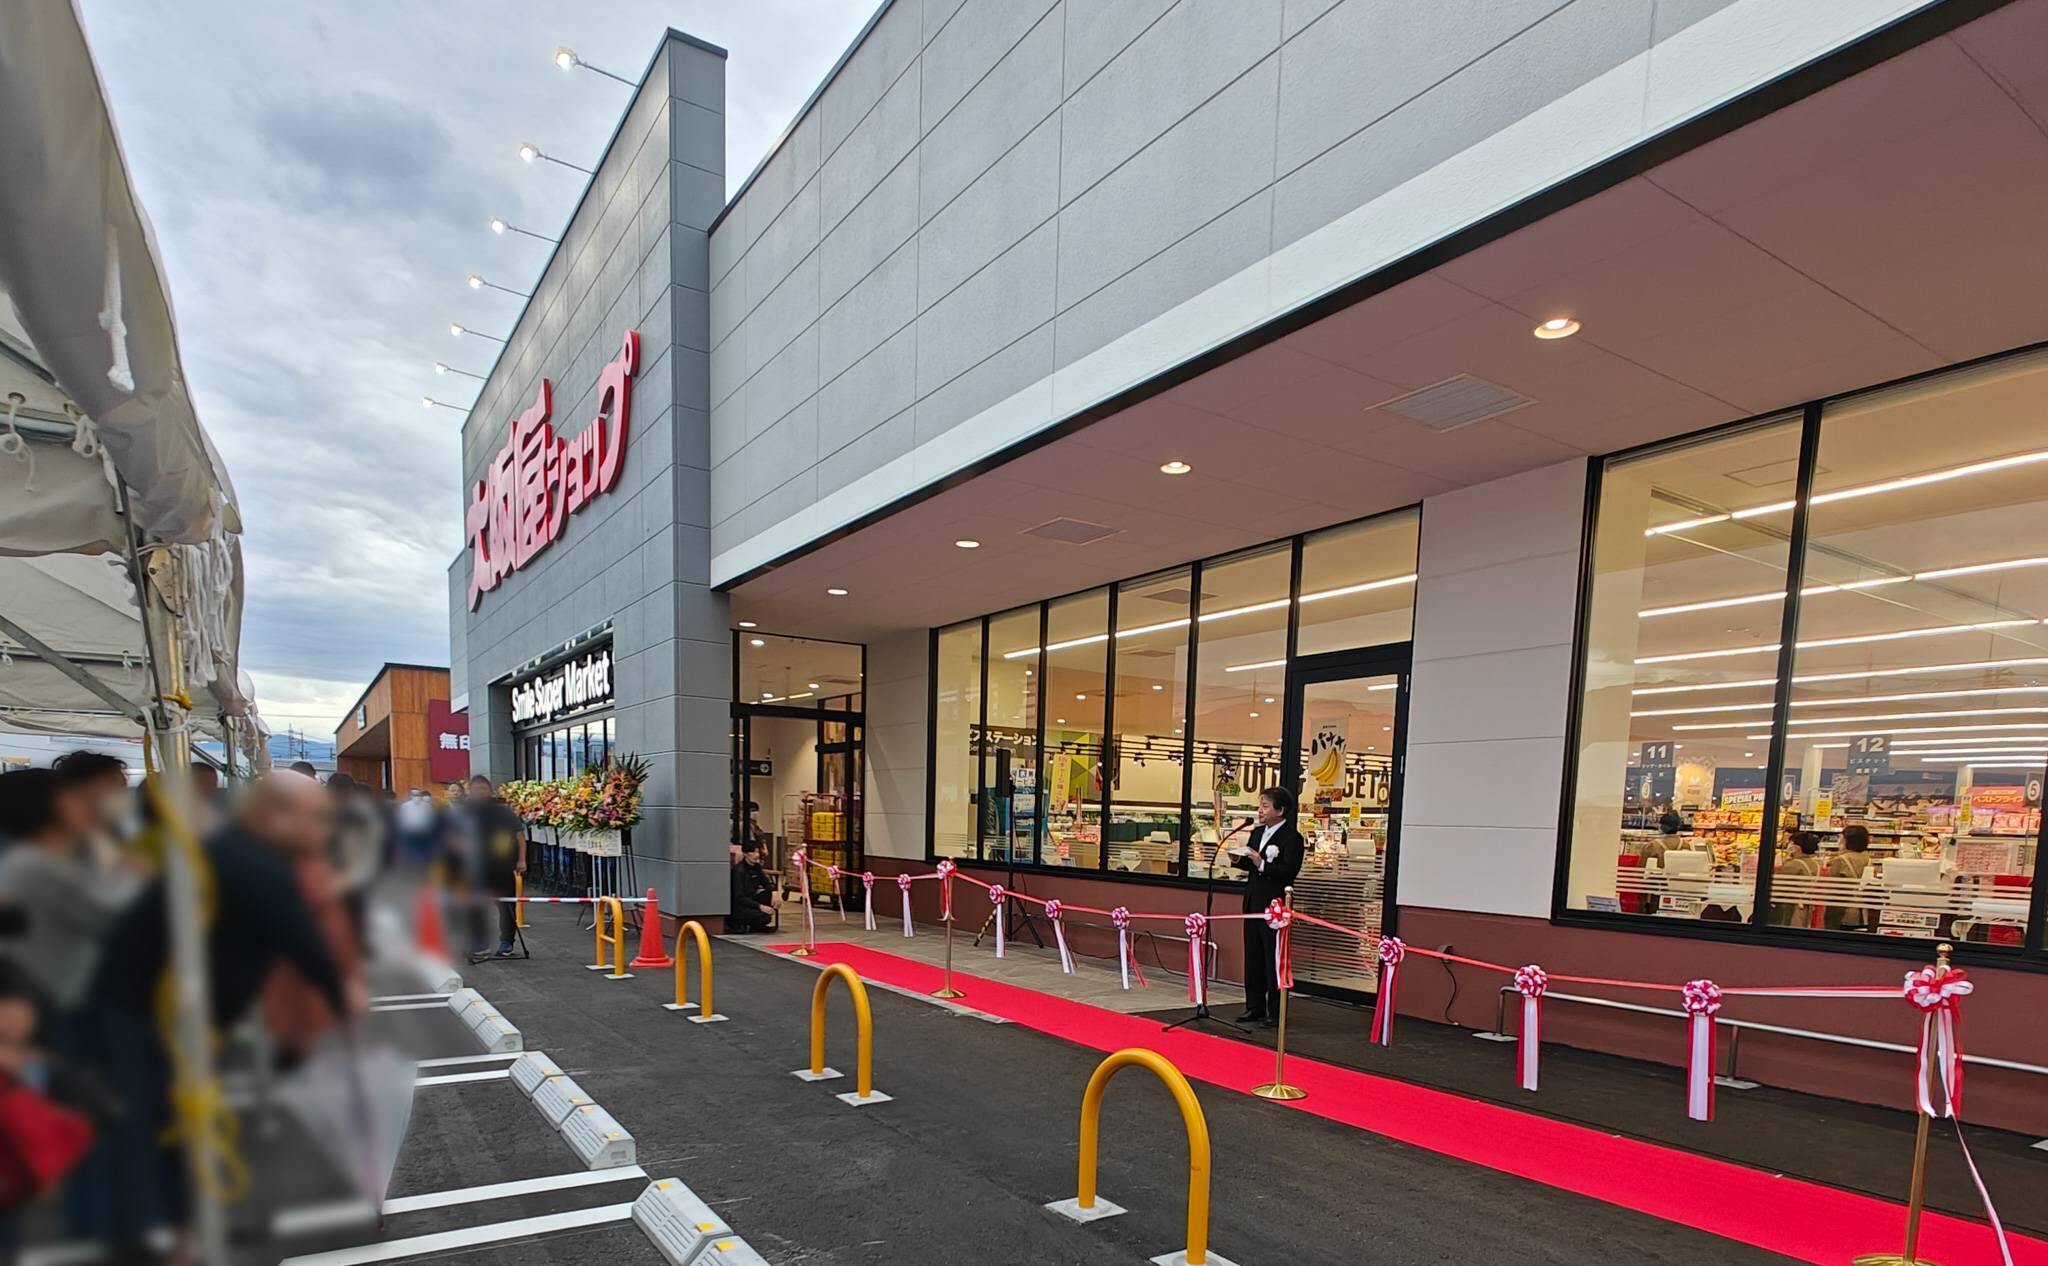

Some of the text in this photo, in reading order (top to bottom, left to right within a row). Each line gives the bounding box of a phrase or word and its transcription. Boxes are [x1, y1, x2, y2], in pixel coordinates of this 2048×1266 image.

[466, 329, 640, 613] 大阪屋ショップ
[512, 651, 610, 723] Smile Super Market
[1647, 745, 1667, 759] 11
[1856, 737, 1884, 753] 12
[2029, 783, 2038, 798] 5
